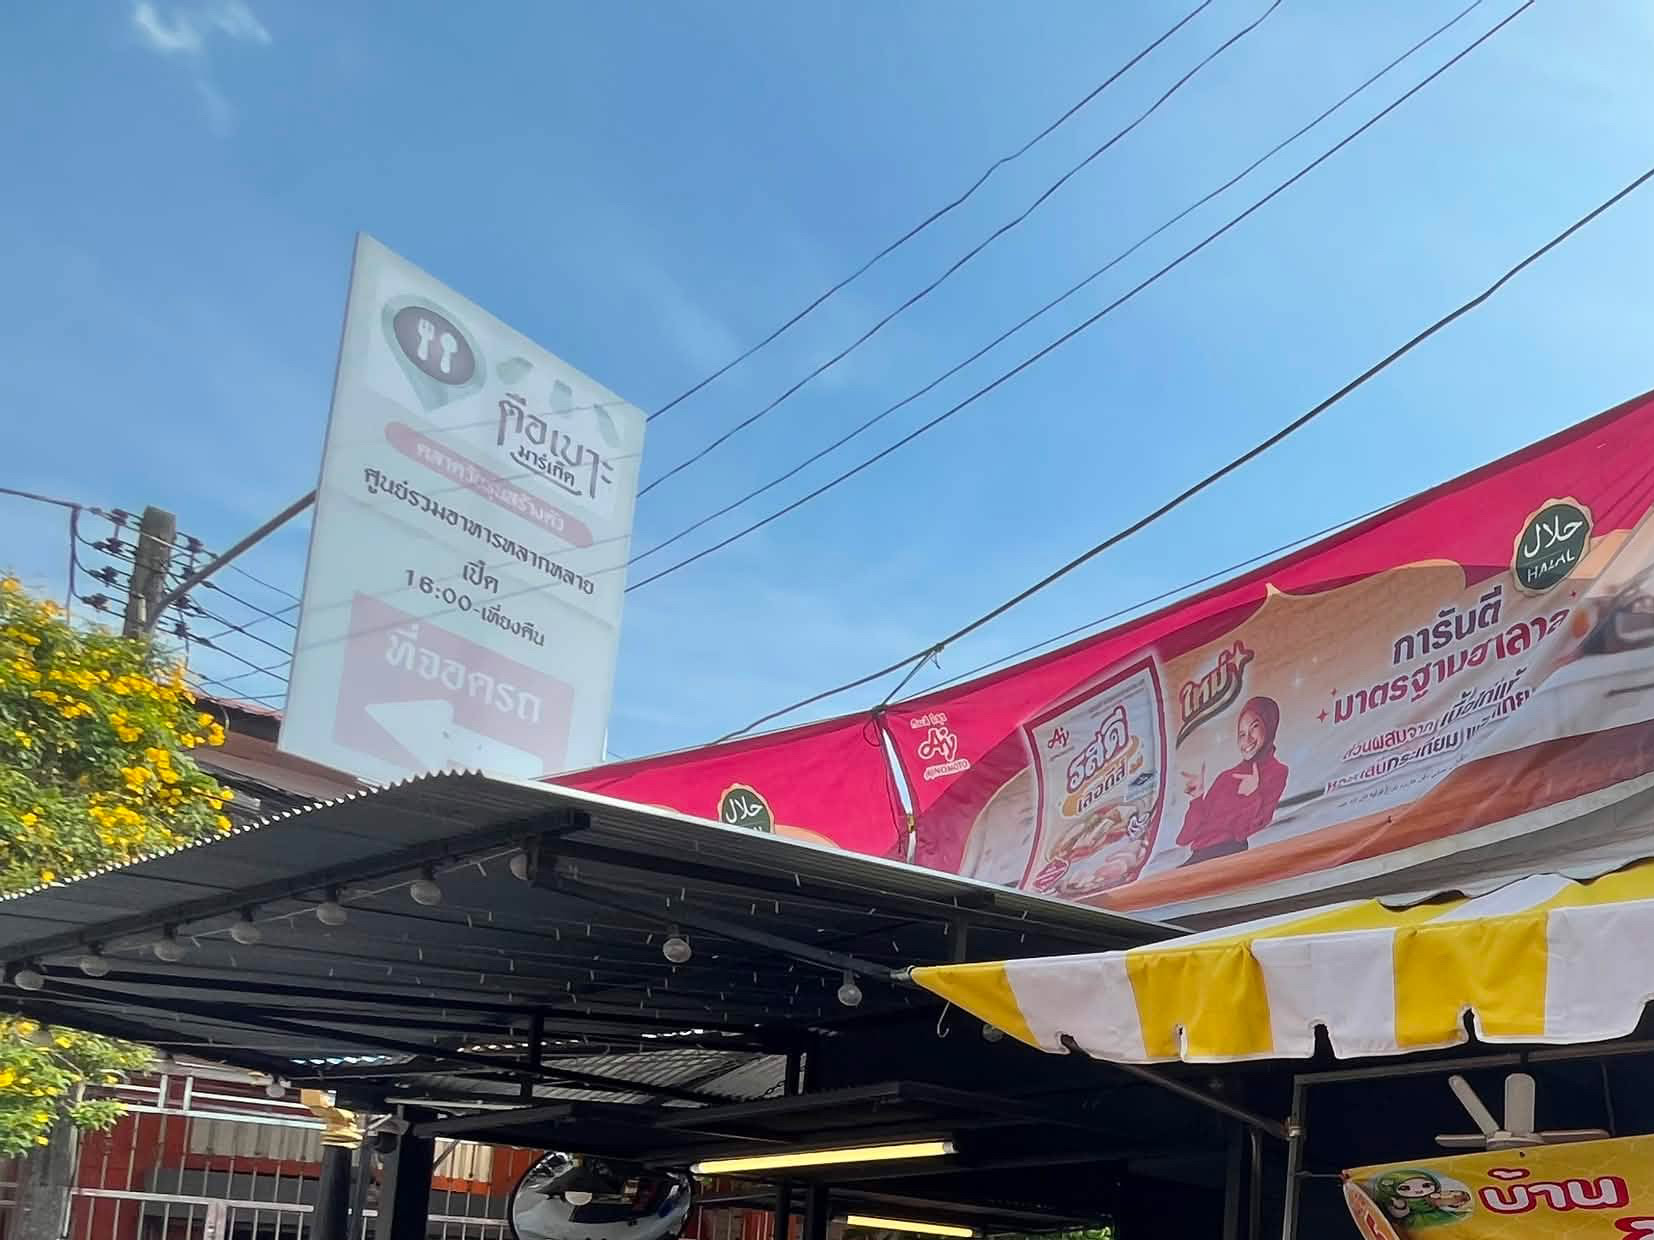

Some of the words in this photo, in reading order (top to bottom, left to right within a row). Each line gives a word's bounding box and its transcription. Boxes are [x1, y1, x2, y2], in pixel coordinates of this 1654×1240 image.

[364, 466, 595, 595] ศูนย์รวมอาหารหลากหลาย
[463, 559, 499, 594] เปิด
[1527, 549, 1575, 582] HALAL
[1393, 585, 1502, 665] การันตี
[384, 622, 544, 723] ที่จอดรถ
[1479, 1167, 1628, 1213] บ้าน
